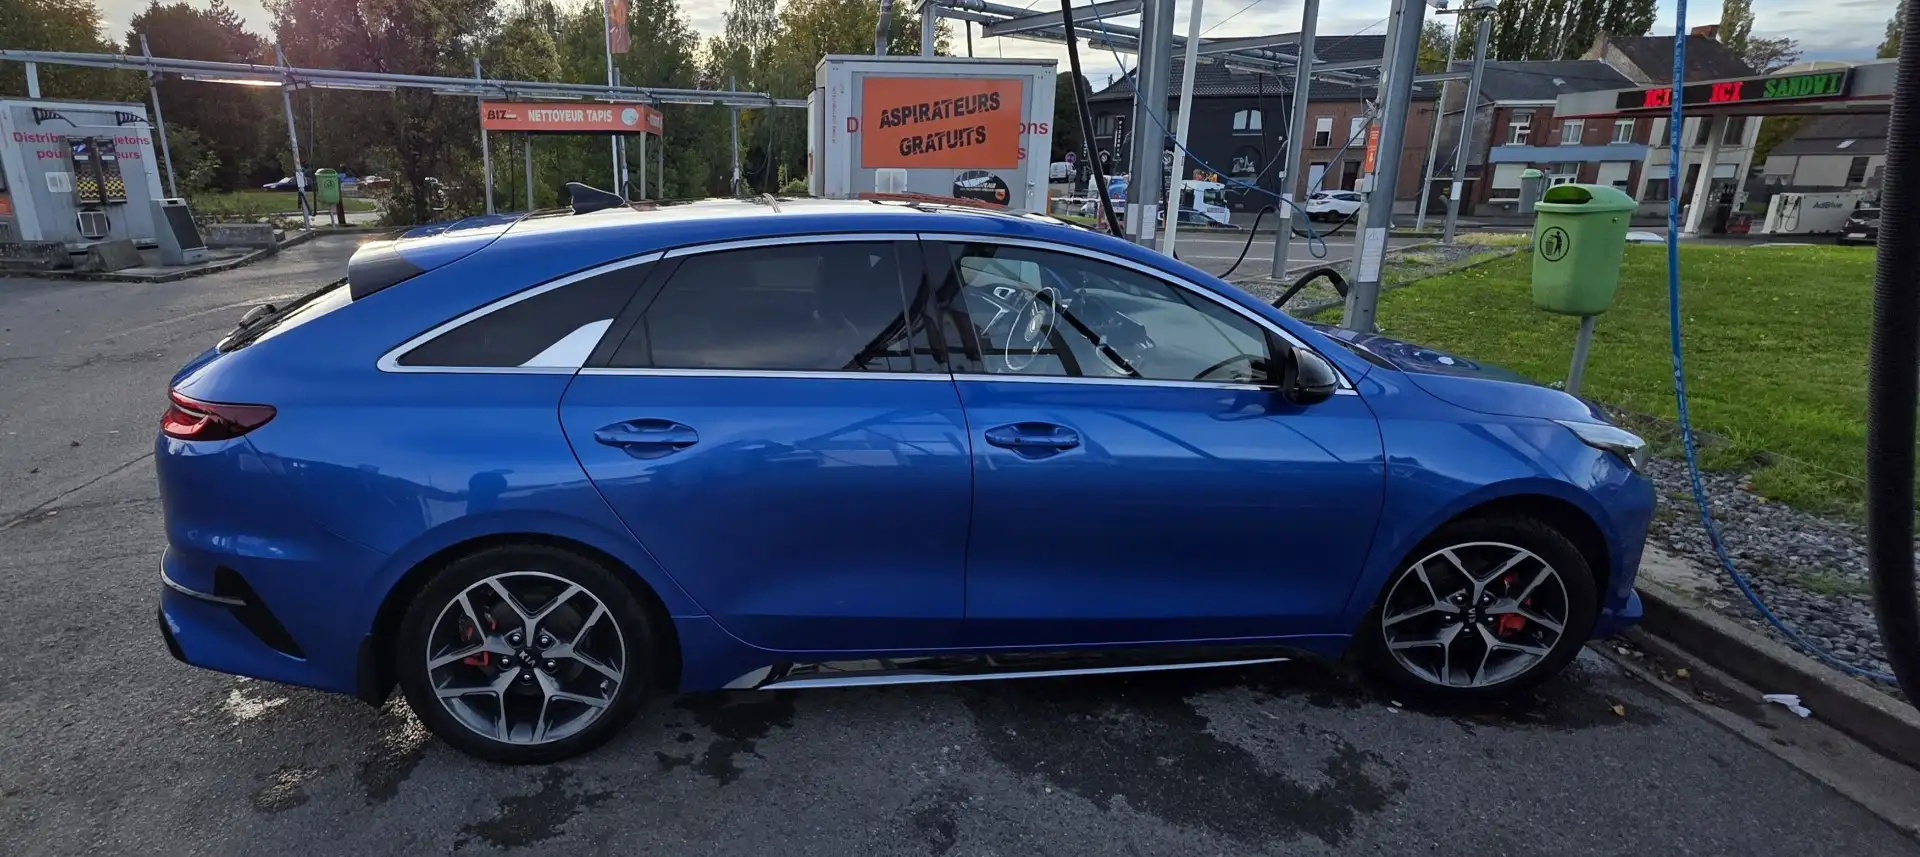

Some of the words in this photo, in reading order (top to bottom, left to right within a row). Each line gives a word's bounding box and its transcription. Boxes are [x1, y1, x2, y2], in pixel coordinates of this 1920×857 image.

[1643, 88, 1672, 108] ICI
[1709, 82, 1743, 102] ICI
[1764, 73, 1841, 98] SANDWI
[528, 109, 584, 122] NETTOYEUR
[586, 109, 612, 122] TAPIS
[879, 91, 1001, 129] ASPIRATEURS
[899, 125, 987, 157] GRATUITS
[1812, 201, 1843, 209] AdBlue
[519, 650, 536, 667] KIA
